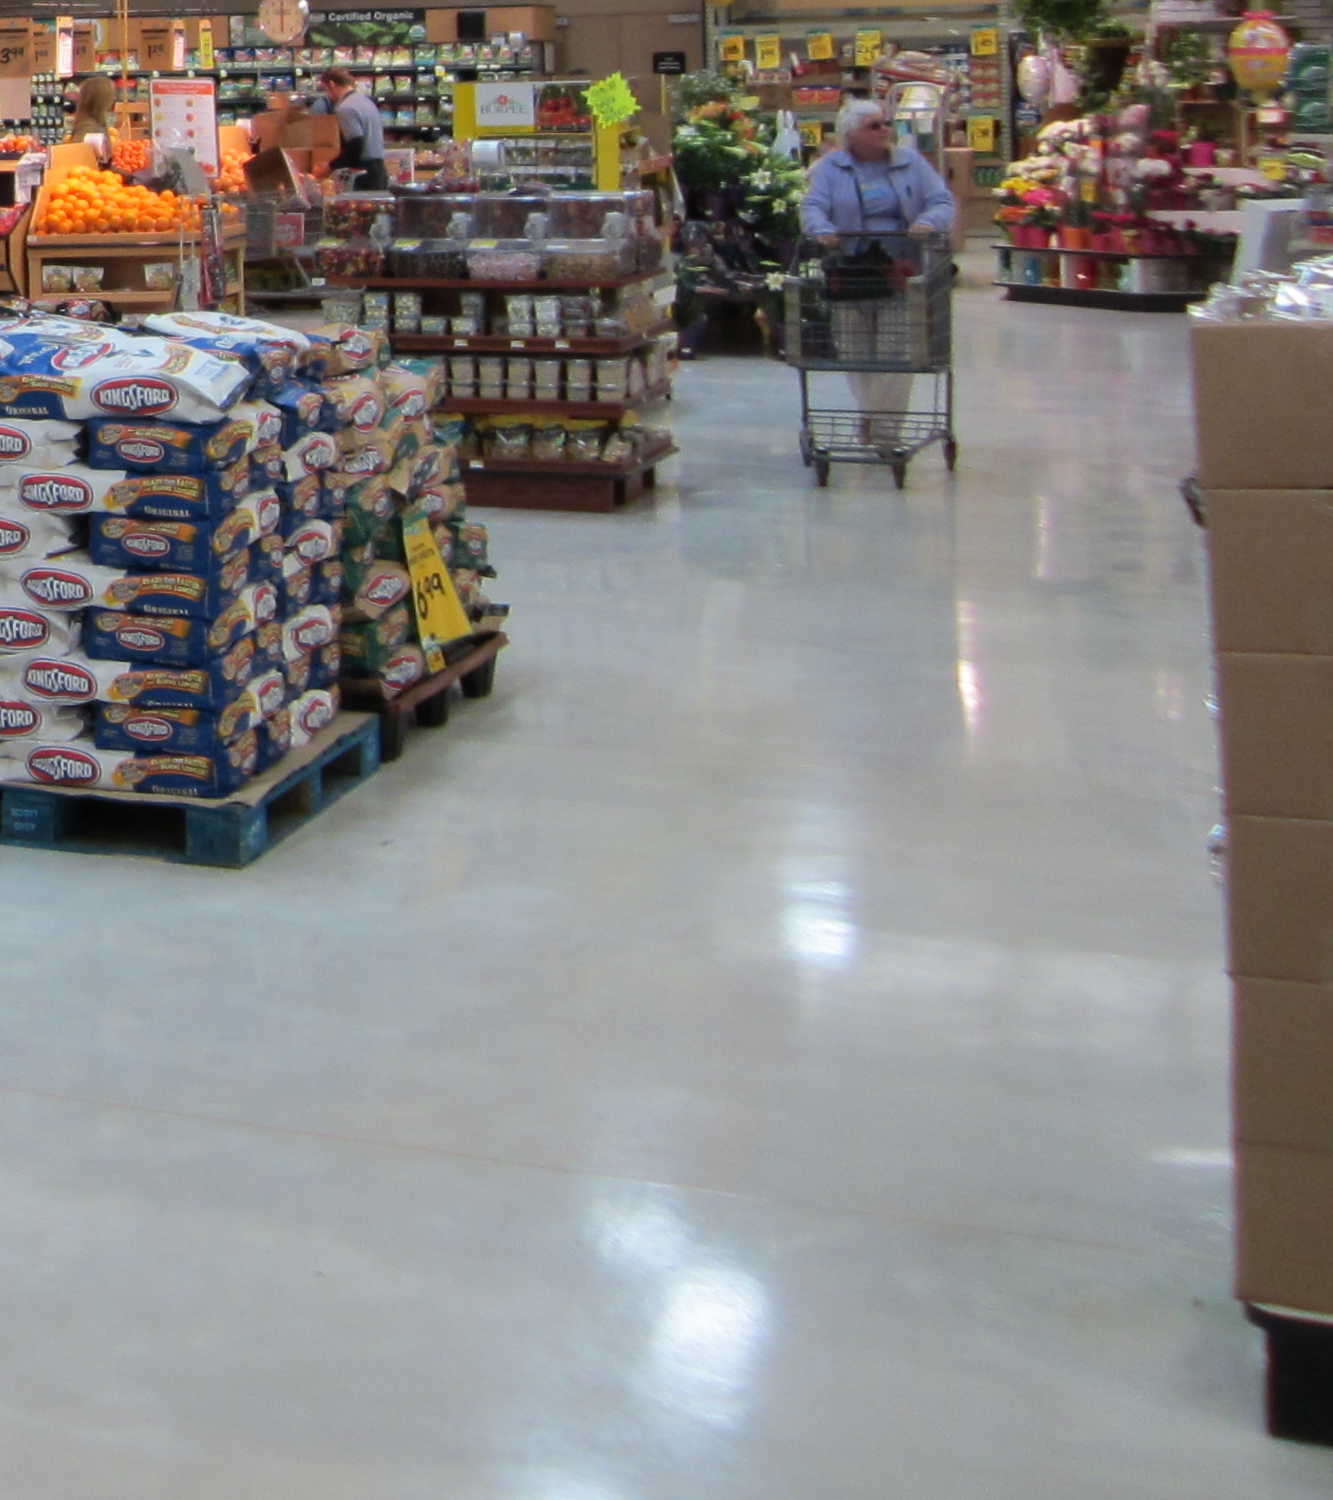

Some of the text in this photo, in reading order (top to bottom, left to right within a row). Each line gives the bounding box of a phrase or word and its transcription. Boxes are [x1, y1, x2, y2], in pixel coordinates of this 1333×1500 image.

[328, 11, 372, 22] Certified
[374, 11, 415, 24] Organic
[99, 384, 170, 411] KINGSFORD
[5, 404, 49, 416] ORIGINAL
[26, 668, 90, 693] KINGSFORD
